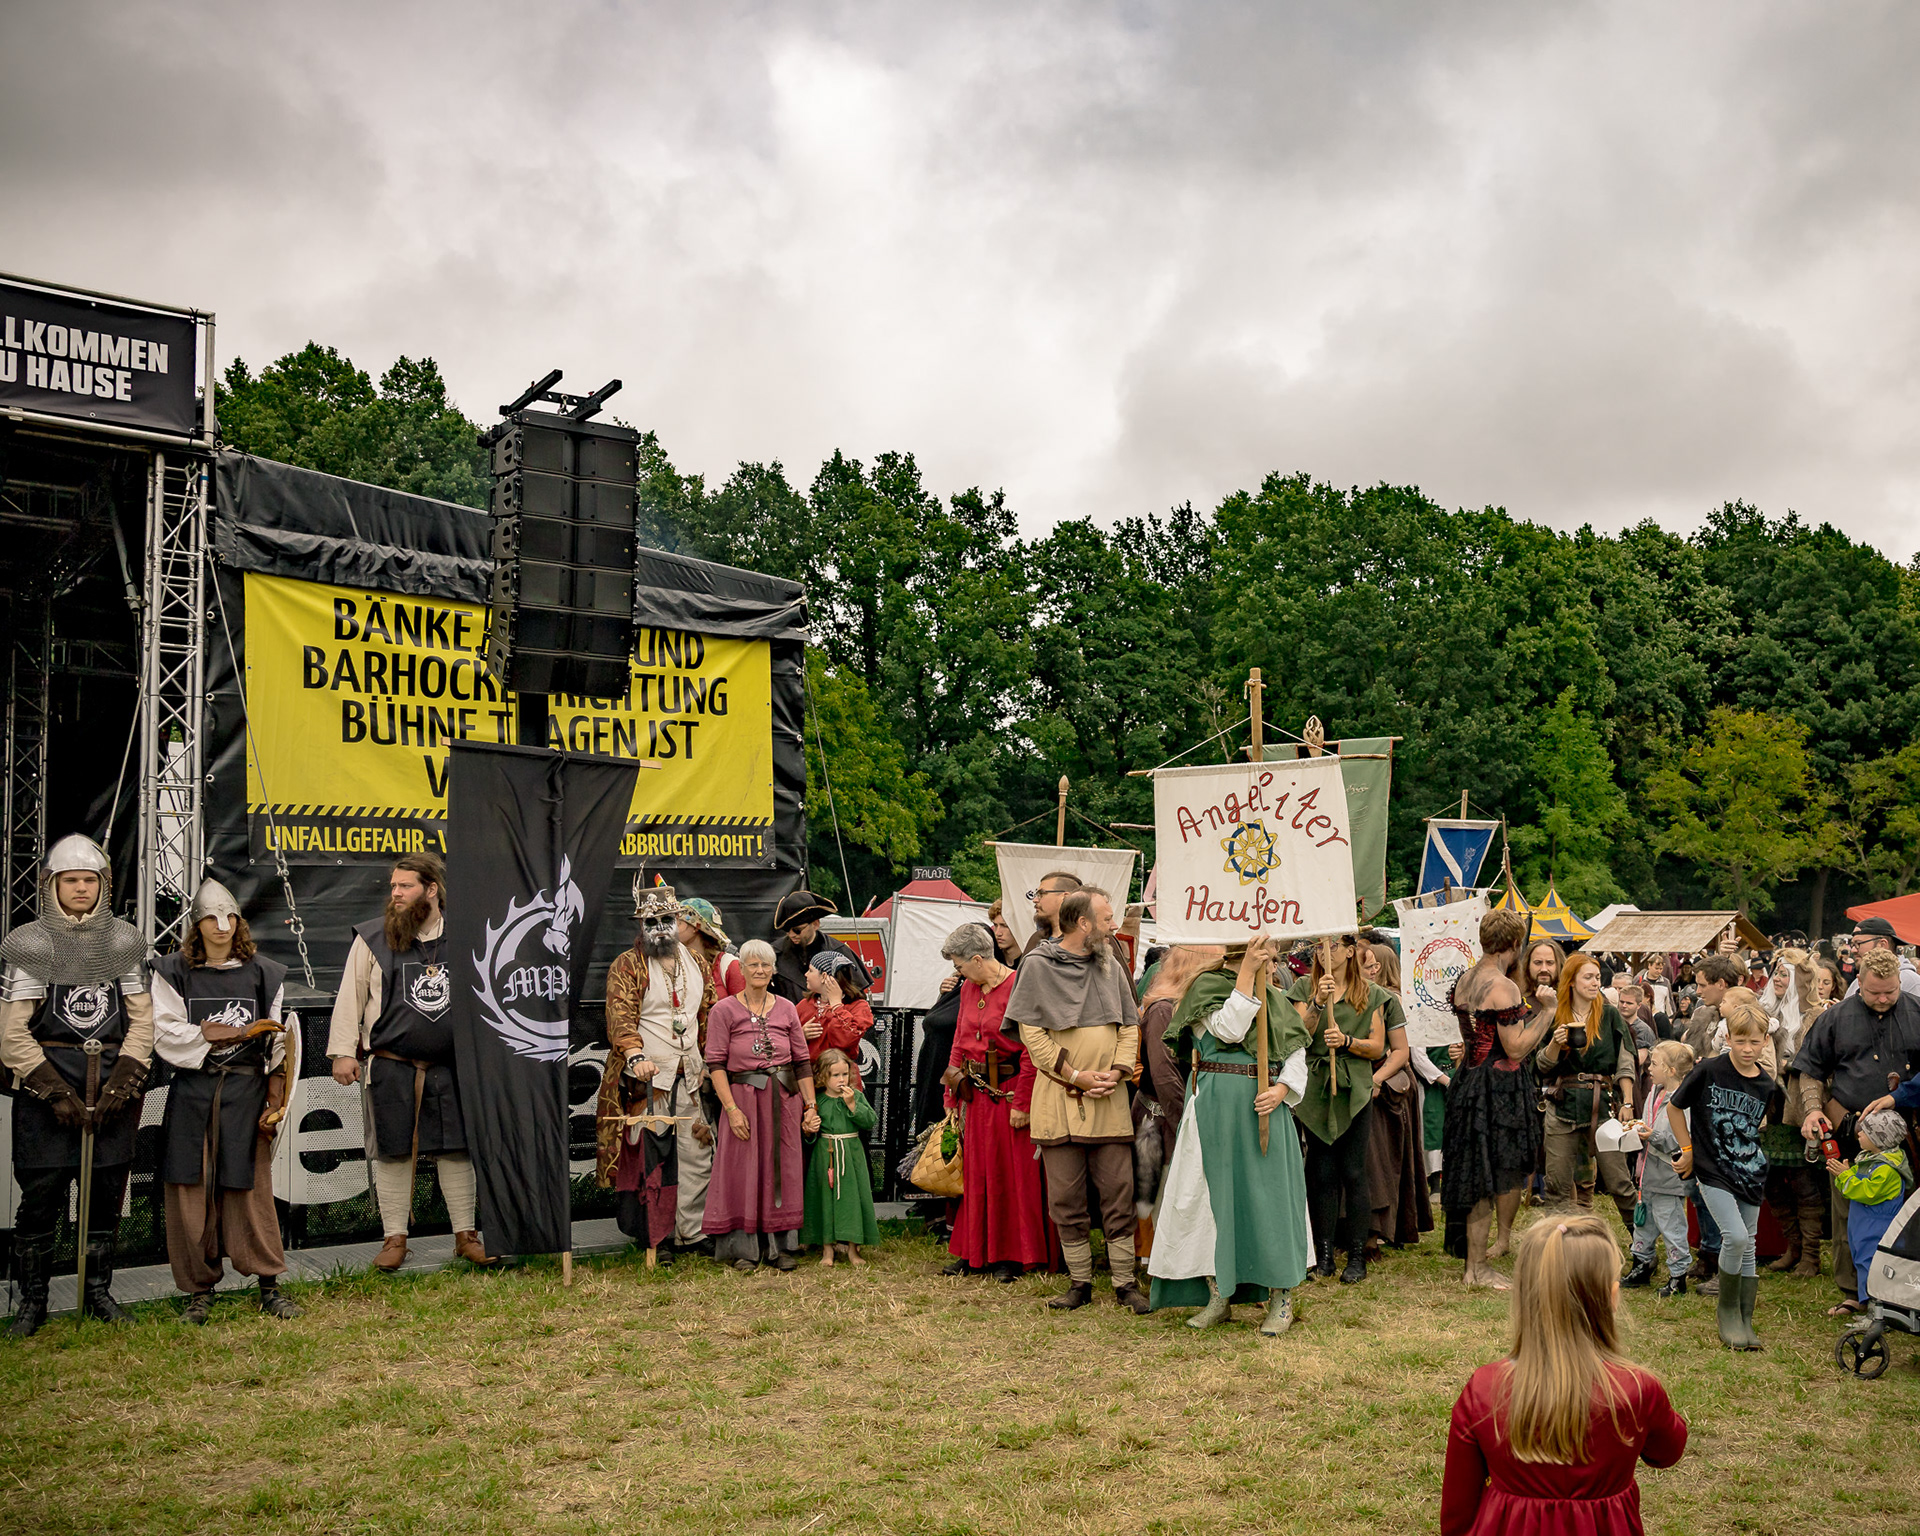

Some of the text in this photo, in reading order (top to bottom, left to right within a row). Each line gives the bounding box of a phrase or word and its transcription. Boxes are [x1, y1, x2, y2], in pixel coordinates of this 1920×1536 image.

[0, 315, 169, 374] LKOMMEN
[26, 354, 132, 402] HAUSE
[633, 628, 705, 670] UND
[303, 645, 517, 703] BARHOCK
[342, 696, 477, 748] BÜHNE
[648, 720, 699, 760] IST
[914, 867, 952, 880] FALAFEL
[1185, 885, 1304, 930] Haufen
[502, 965, 570, 1004] MP
